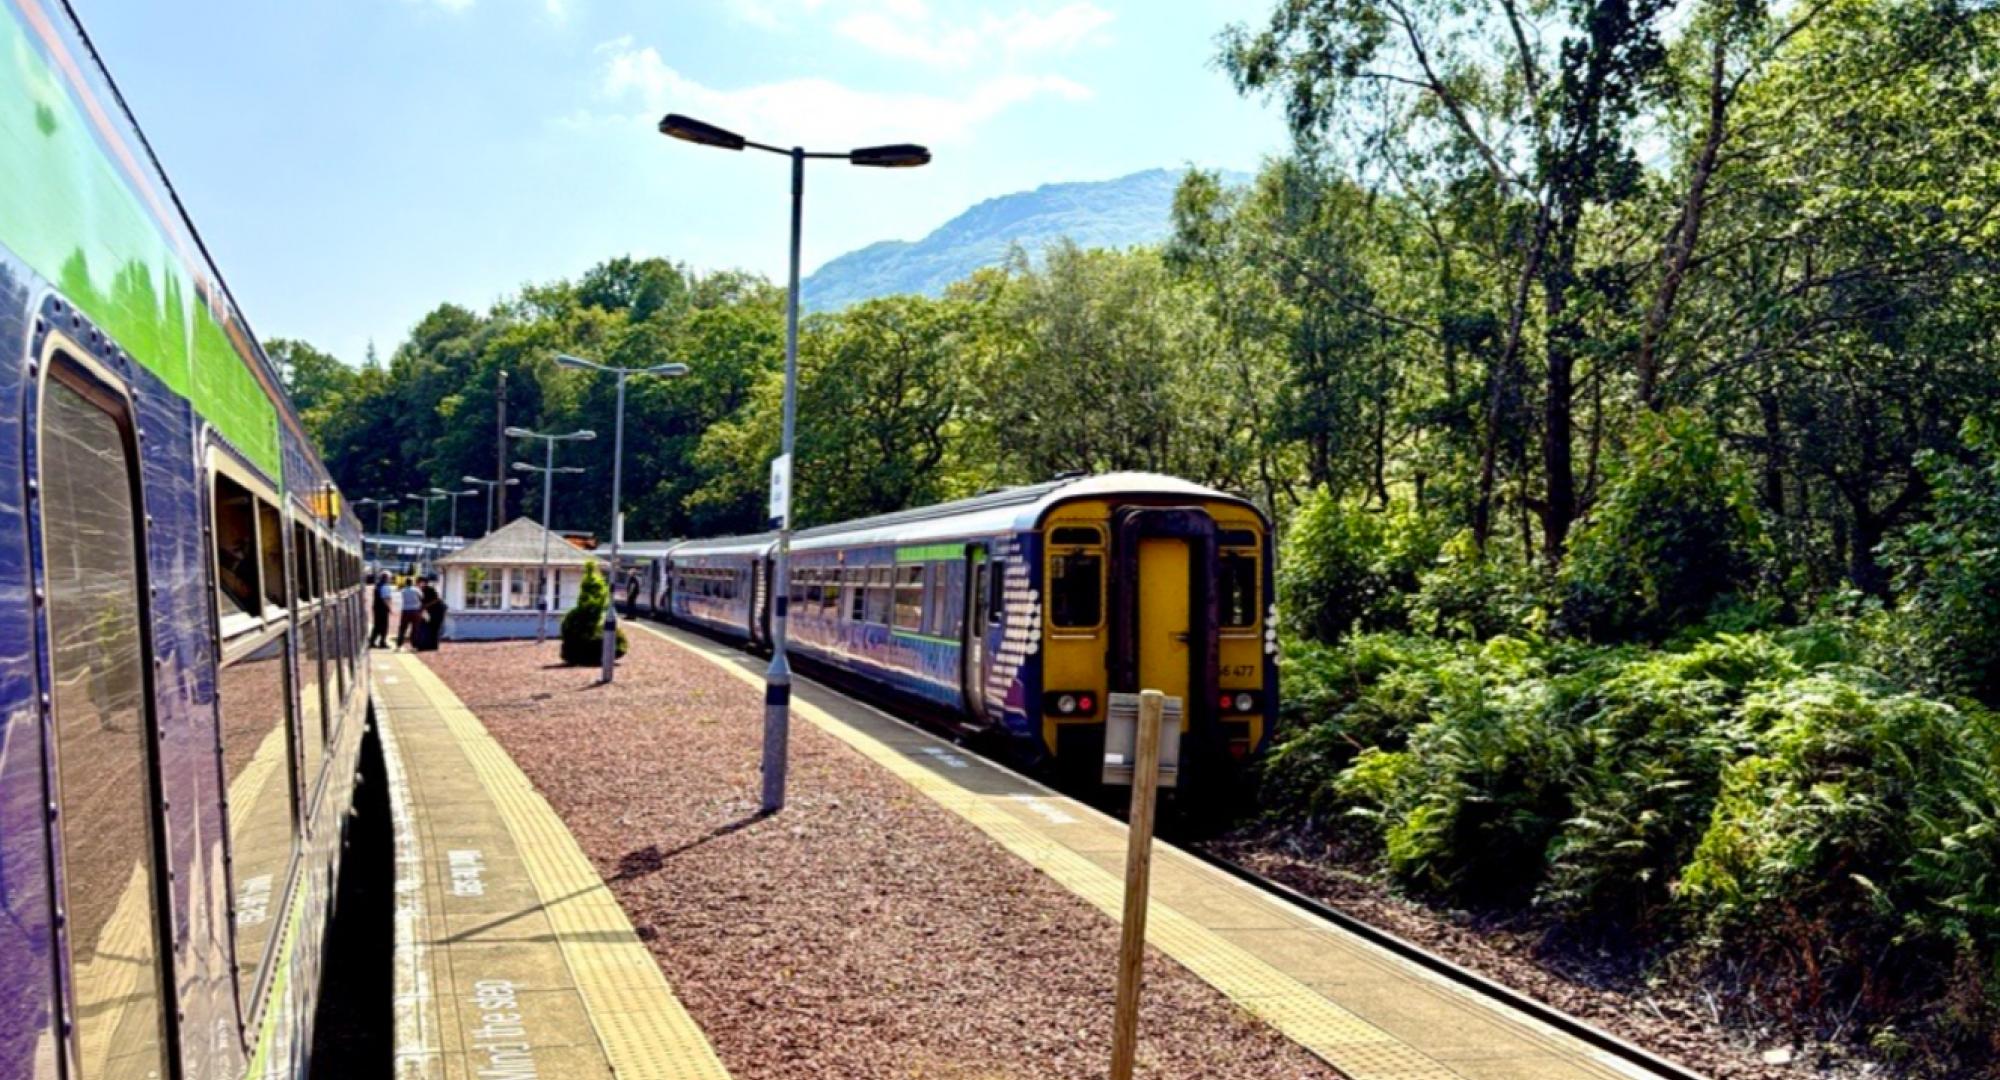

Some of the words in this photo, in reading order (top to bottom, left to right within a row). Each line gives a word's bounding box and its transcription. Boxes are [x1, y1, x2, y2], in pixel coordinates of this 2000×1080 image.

[1233, 665, 1256, 677] 477
[467, 979, 527, 1009] step
[471, 1013, 527, 1038] the
[471, 1042, 538, 1080] Mind
